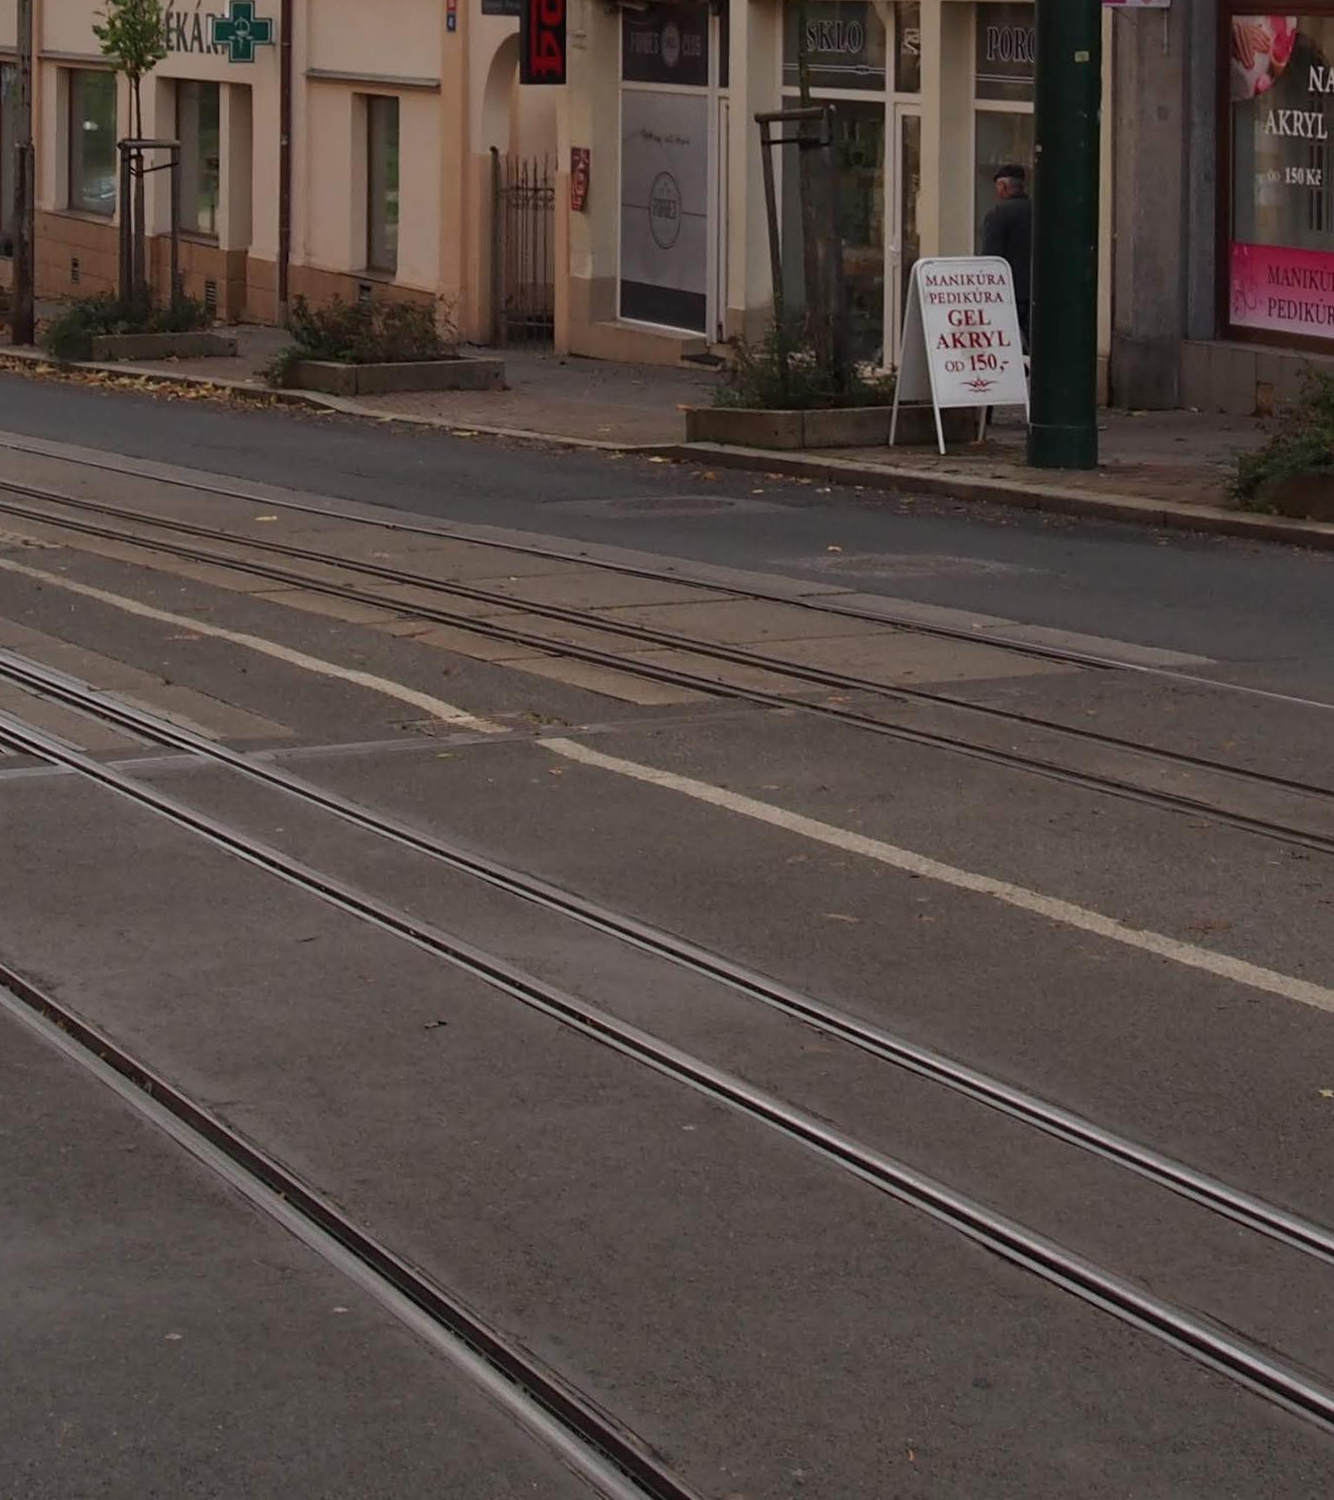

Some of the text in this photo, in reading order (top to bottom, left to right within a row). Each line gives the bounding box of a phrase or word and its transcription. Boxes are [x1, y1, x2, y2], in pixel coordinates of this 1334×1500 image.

[806, 20, 863, 53] SKLO
[1266, 108, 1328, 139] AKRYL
[1285, 167, 1305, 185] 150
[926, 270, 1006, 286] MANIKÚRA
[929, 288, 1003, 304] PEDIKÚRA
[948, 308, 991, 327] GEL
[936, 331, 1011, 349] AKRYL
[945, 353, 1009, 373] OD 150,-
